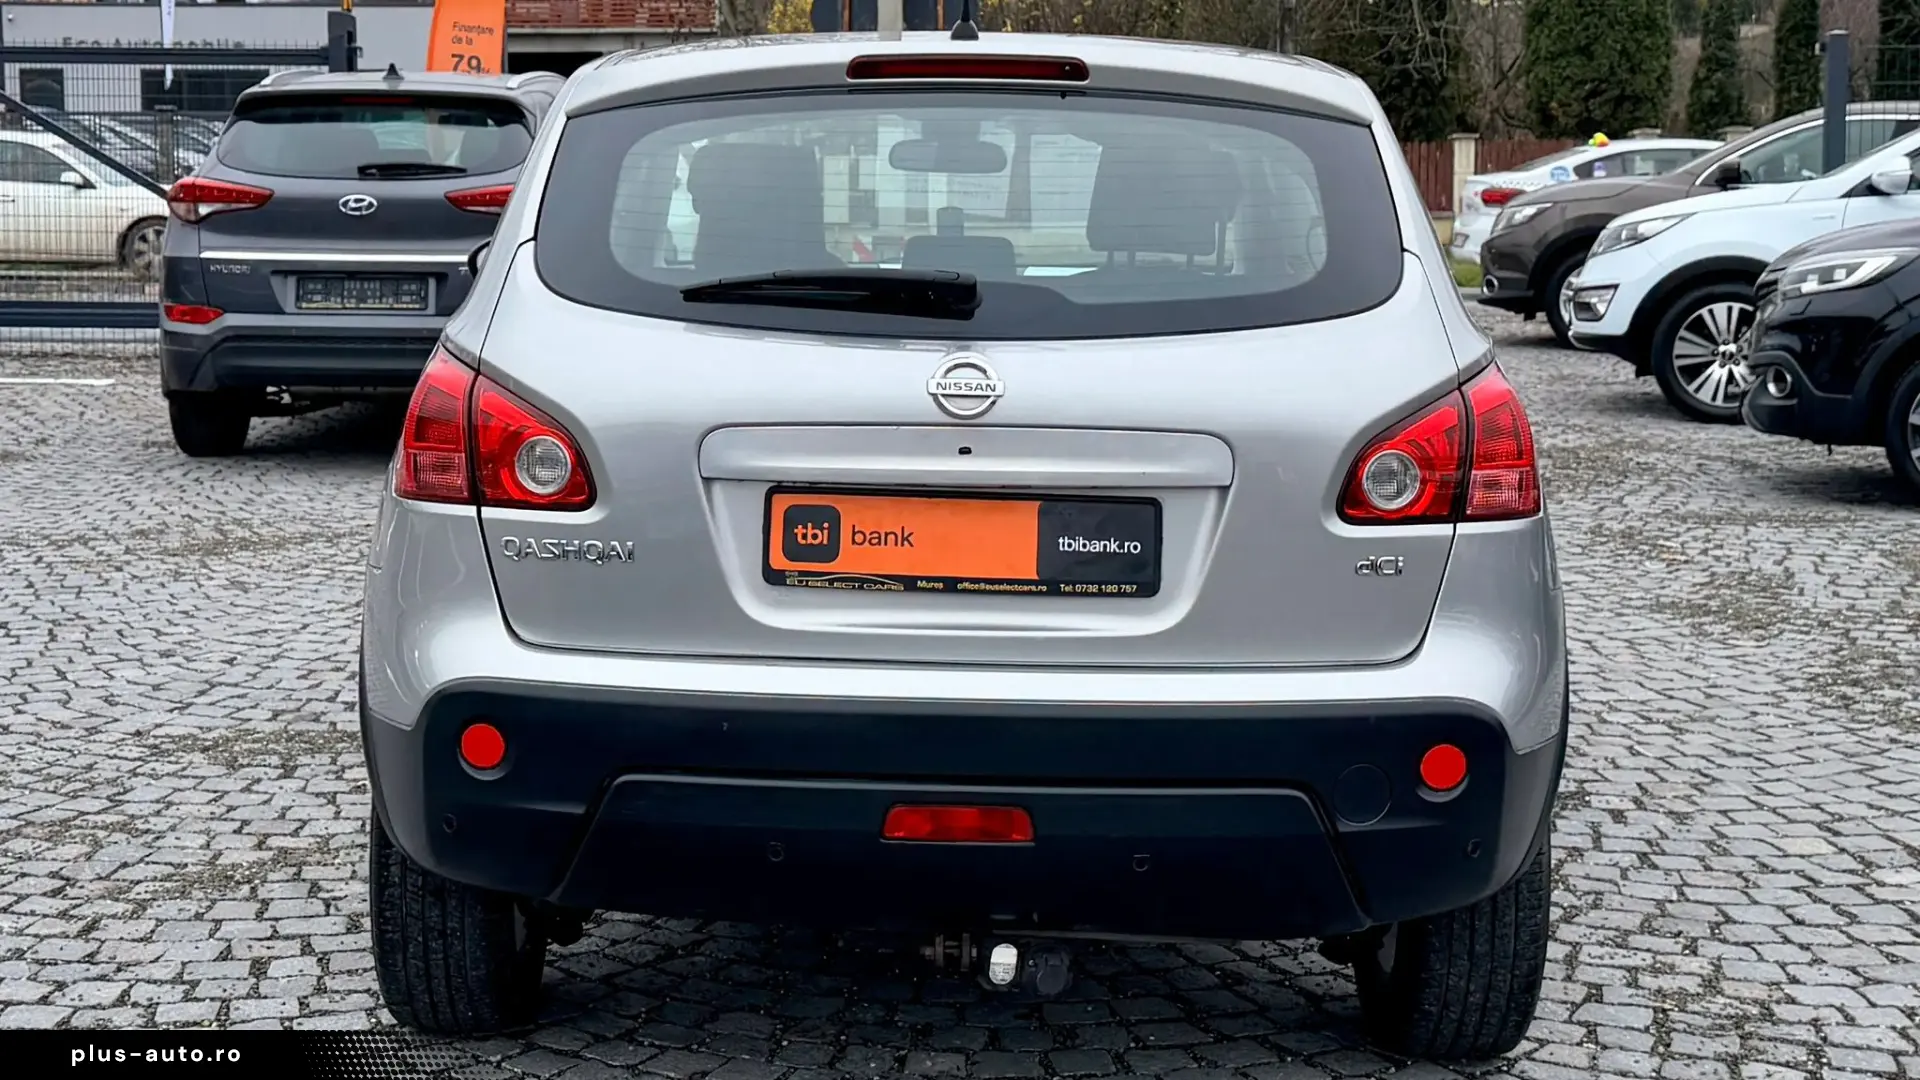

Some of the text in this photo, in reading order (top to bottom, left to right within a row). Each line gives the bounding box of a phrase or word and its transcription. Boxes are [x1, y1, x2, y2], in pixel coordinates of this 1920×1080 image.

[451, 34, 473, 46] de la
[936, 381, 996, 393] NISSAN
[793, 522, 914, 548] tbi bank
[500, 536, 635, 565] QASHQAI
[1058, 536, 1141, 554] tbibank.ro
[1355, 555, 1404, 576] dCi
[808, 580, 861, 589] SELECT
[863, 583, 904, 591] CARS
[1075, 584, 1099, 593] 0732
[1100, 584, 1118, 593] 120
[1120, 584, 1137, 593] 757
